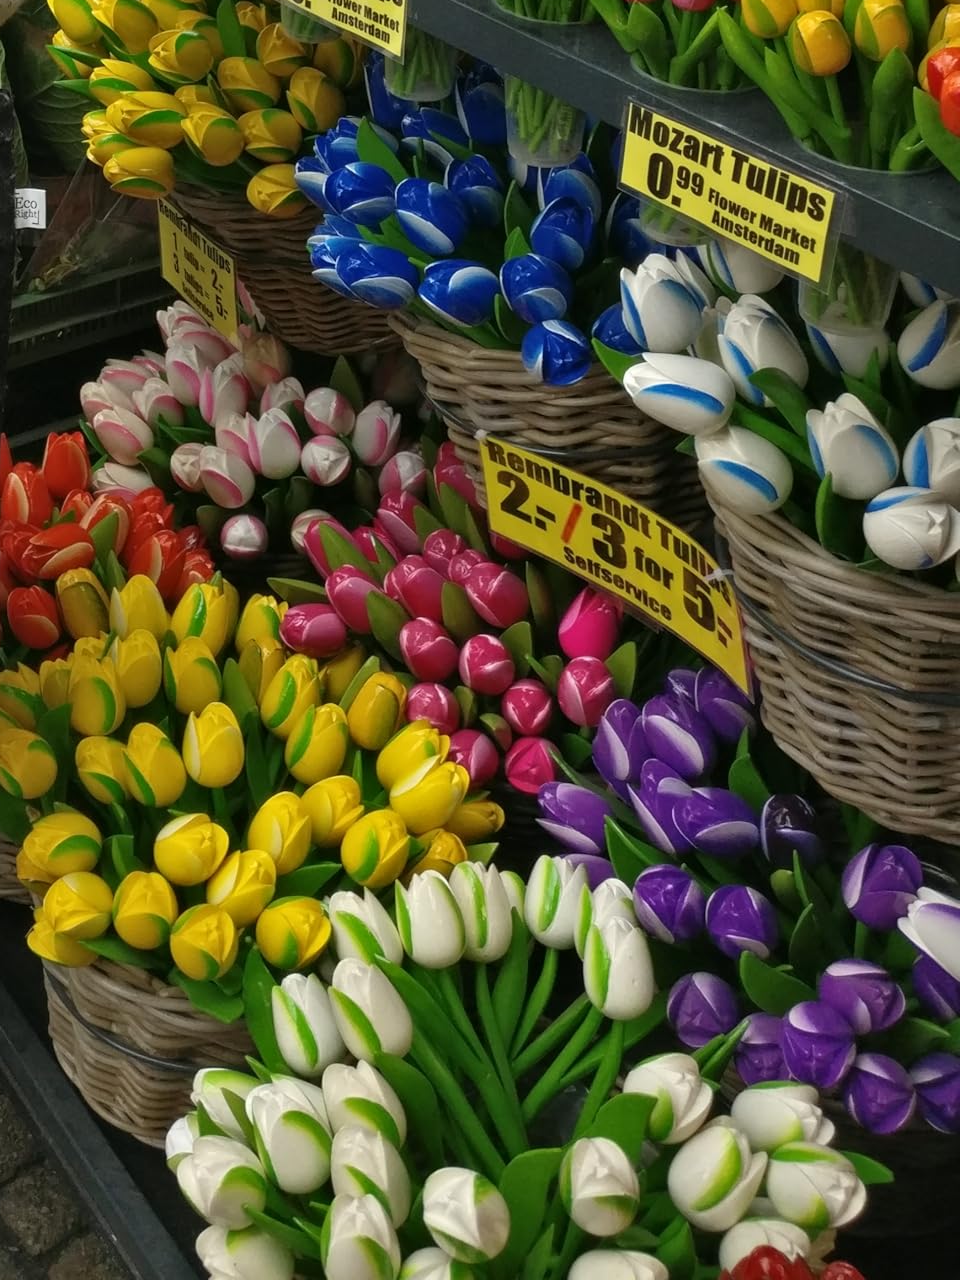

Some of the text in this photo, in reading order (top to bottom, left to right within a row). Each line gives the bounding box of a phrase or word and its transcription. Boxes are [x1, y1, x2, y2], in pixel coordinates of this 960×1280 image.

[331, 7, 390, 44] Amsterdam
[363, 5, 400, 33] Market
[629, 104, 827, 222] Mozart Tulips
[15, 197, 37, 209] Eco
[708, 187, 757, 224] Flower
[759, 213, 817, 254] Market
[173, 232, 178, 251] 1
[202, 238, 231, 274] Tulips
[711, 210, 800, 265] Amsterdam
[173, 252, 180, 274] 3
[486, 439, 652, 539] Rembrandt
[591, 514, 627, 569] 3
[633, 546, 674, 591] for
[563, 546, 672, 621] Selfservice
